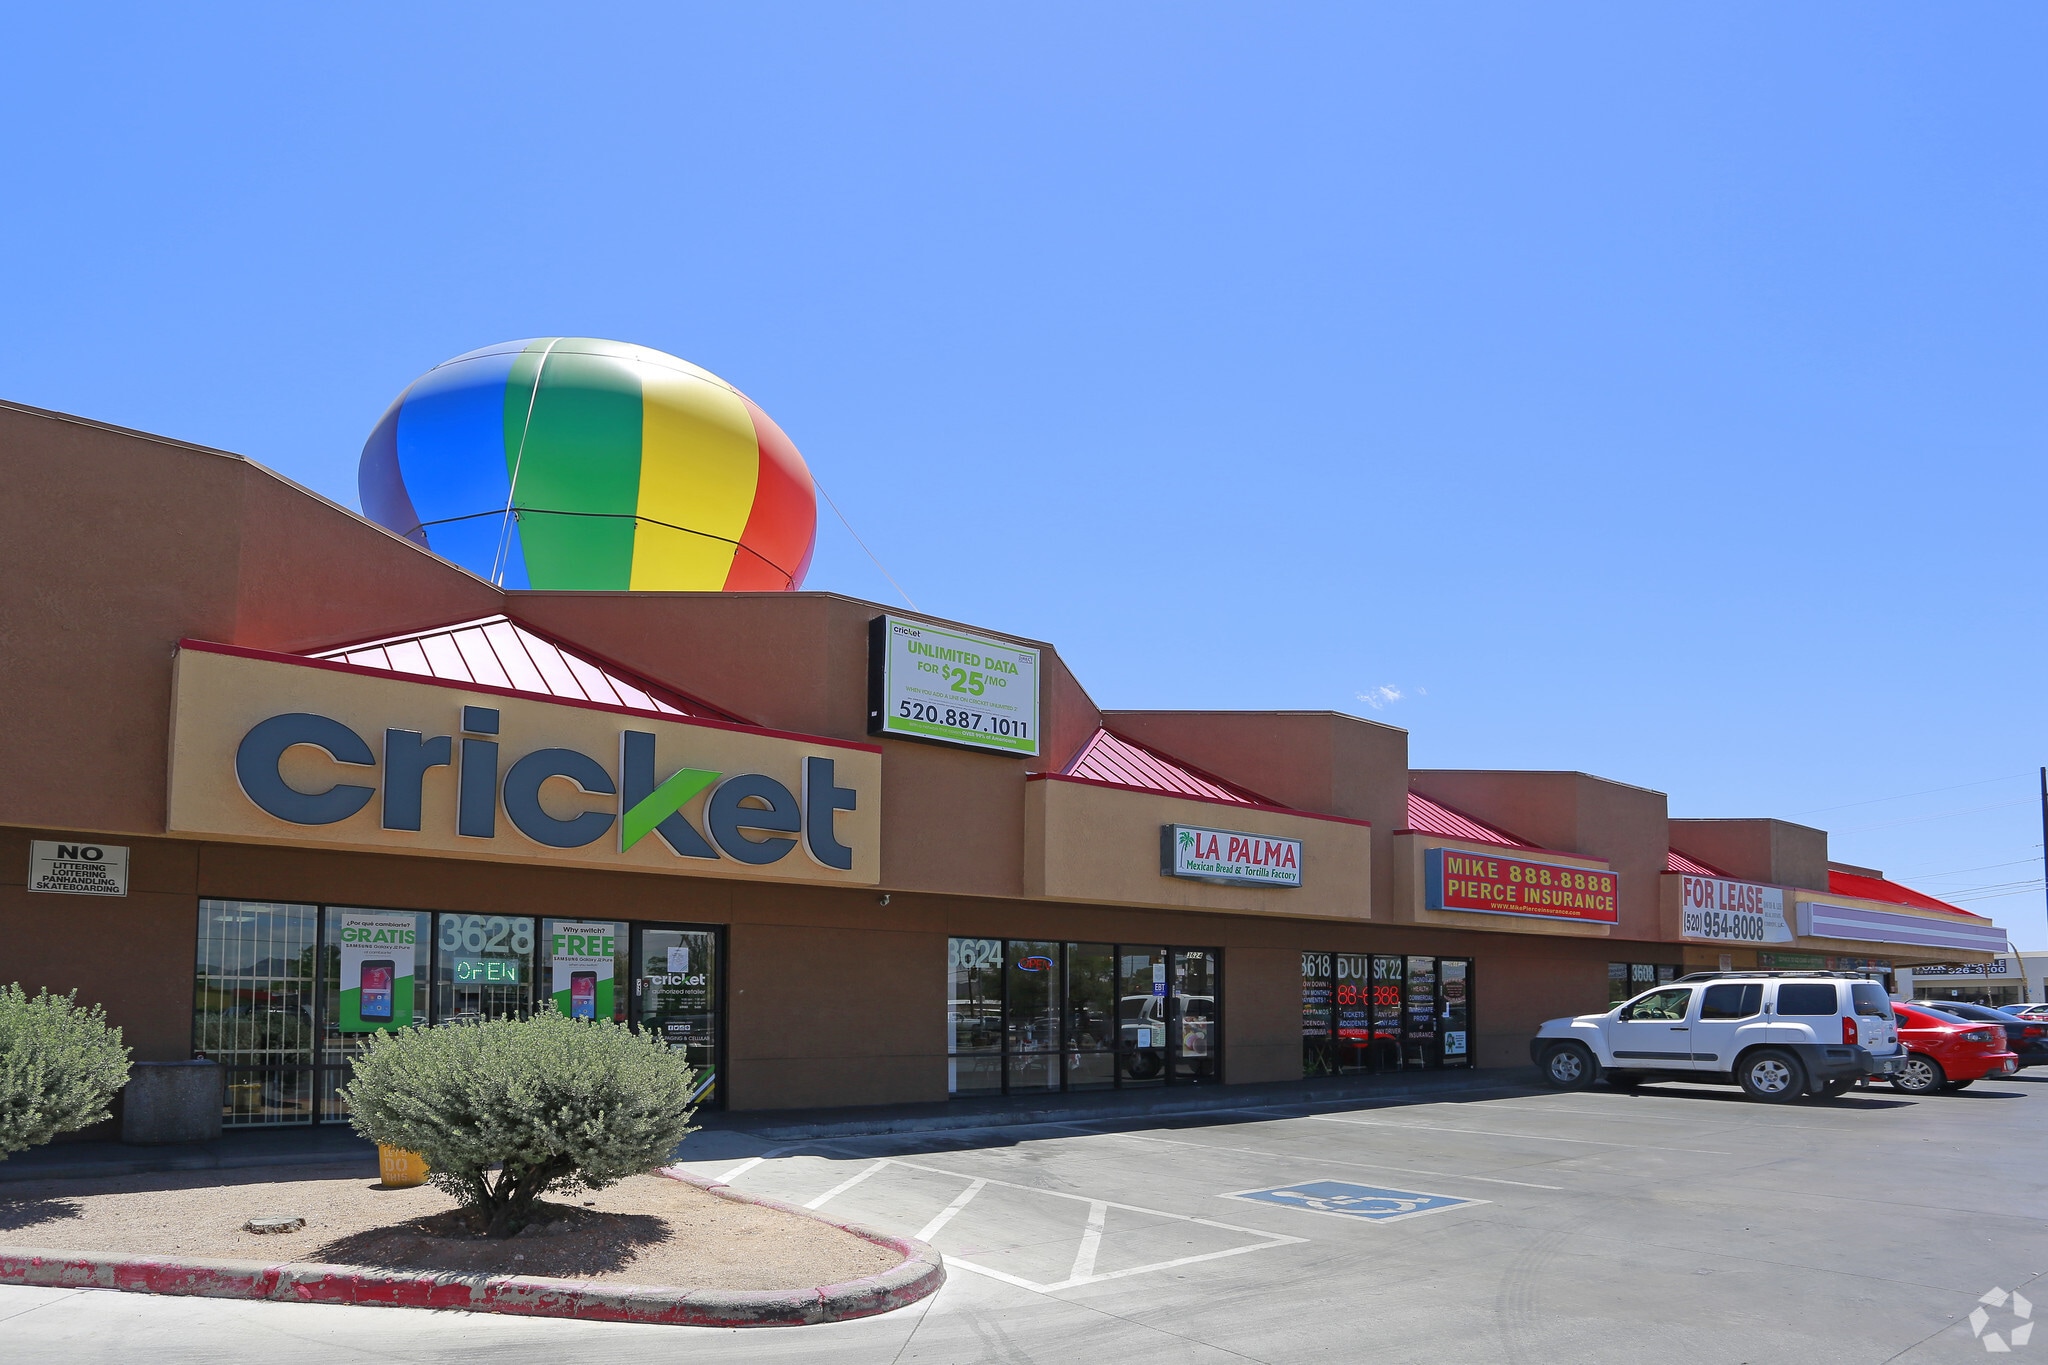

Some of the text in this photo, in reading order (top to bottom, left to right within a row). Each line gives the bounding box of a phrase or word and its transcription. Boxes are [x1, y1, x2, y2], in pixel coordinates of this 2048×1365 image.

[893, 626, 921, 638] cricket
[907, 640, 981, 667] UNLIMITED
[984, 657, 1019, 675] DATA
[917, 661, 939, 674] FOR
[905, 686, 921, 694] WHEN
[969, 698, 989, 706] CRICKET
[899, 700, 1027, 738] 520.887.1011
[235, 704, 857, 871] cricket
[57, 844, 104, 861] NO
[1195, 832, 1297, 869] LA PALMA
[52, 869, 107, 879] LOITERING
[53, 862, 106, 872] LITTERING
[1186, 860, 1297, 882] Mexican Bread & Tortilla Factory
[1447, 856, 1612, 893] MIKE 888.8888
[36, 882, 120, 893] SKATEBOARDING
[42, 875, 116, 886] PANHANDLING
[1448, 879, 1614, 911] PIERCE INSURANCE
[1683, 877, 1763, 914] FOR LEASE
[438, 913, 535, 955] 3628
[563, 926, 579, 934] Why
[1684, 911, 1764, 940] (520) 954-8008
[340, 927, 416, 945] GRATIS
[553, 934, 615, 957] FREE
[948, 939, 1004, 969] 3624
[457, 961, 515, 981] OPEN
[1019, 957, 1051, 971] OPEN
[1301, 954, 1331, 977] 3618
[1373, 958, 1387, 979] SR
[1389, 959, 1402, 980] 22
[1632, 964, 1655, 982] 3608
[651, 973, 706, 986] cricket
[1154, 983, 1166, 991] EBT
[1339, 1019, 1368, 1027] ACCIDENTS
[1408, 1031, 1434, 1039] INSURANCE
[384, 1158, 408, 1172] DO
